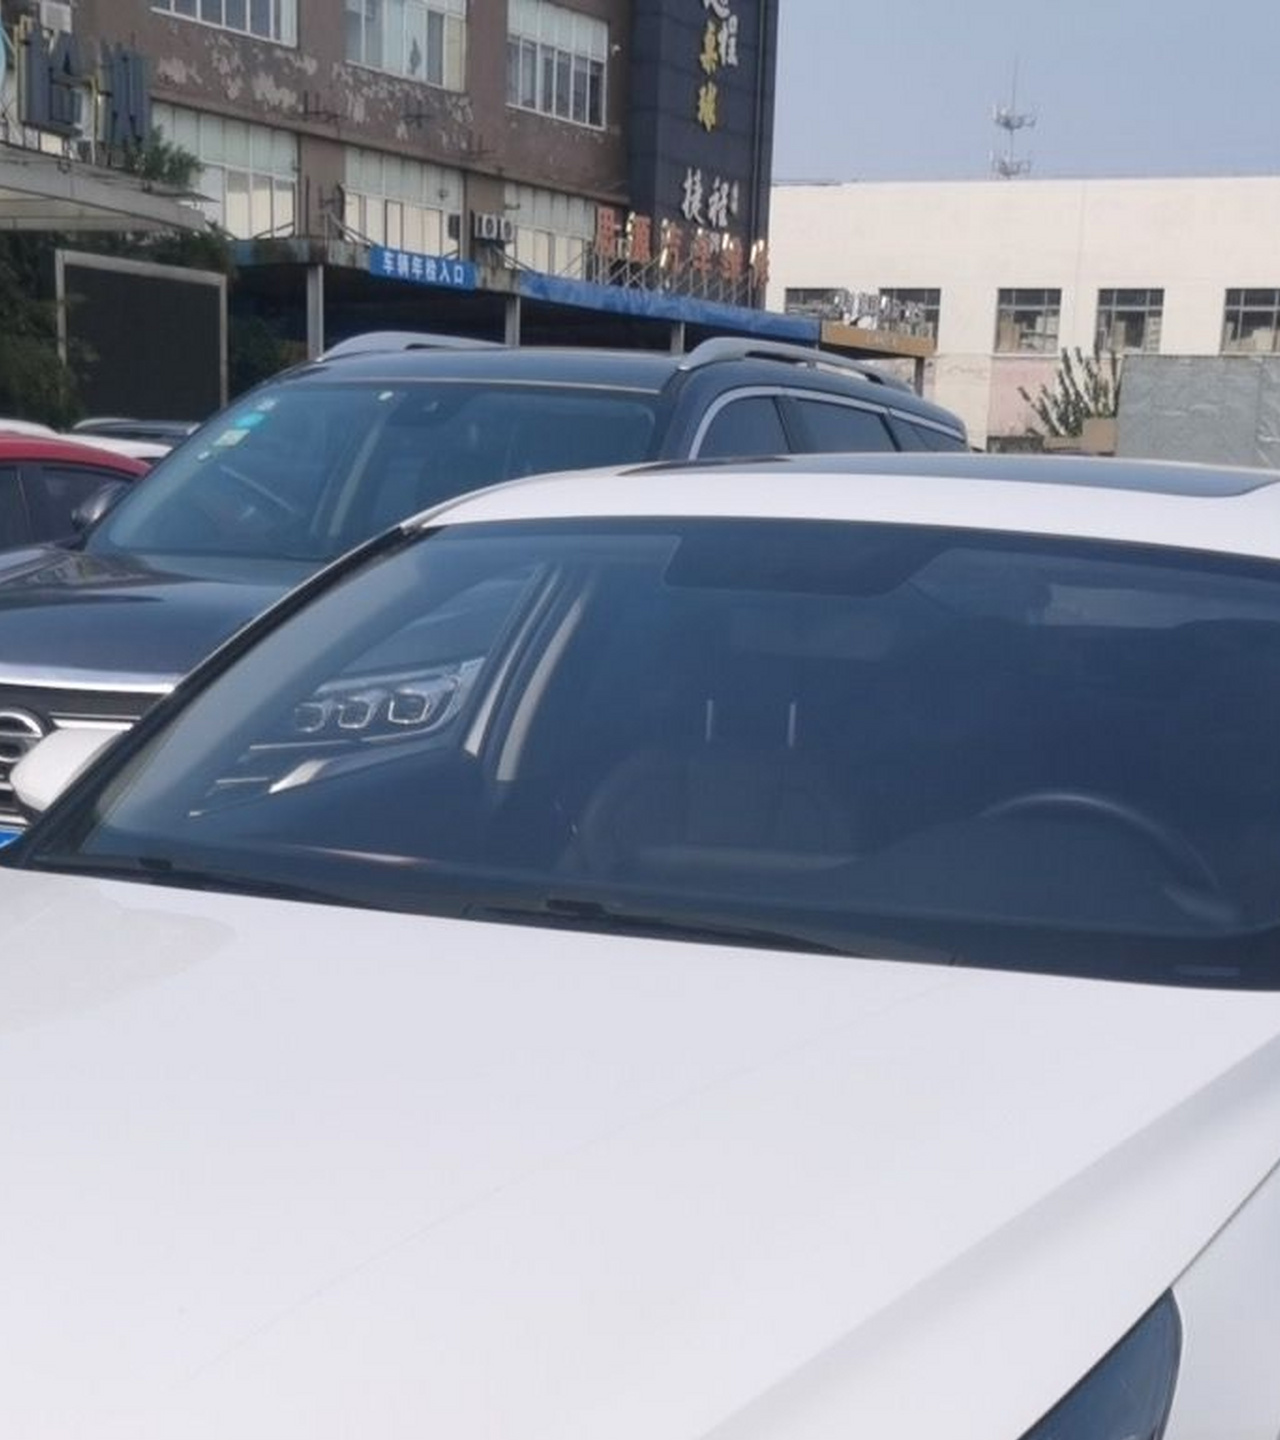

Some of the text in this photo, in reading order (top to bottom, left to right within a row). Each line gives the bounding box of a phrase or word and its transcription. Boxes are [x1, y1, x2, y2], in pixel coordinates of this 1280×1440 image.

[382, 250, 465, 285] 车辆年检入口
